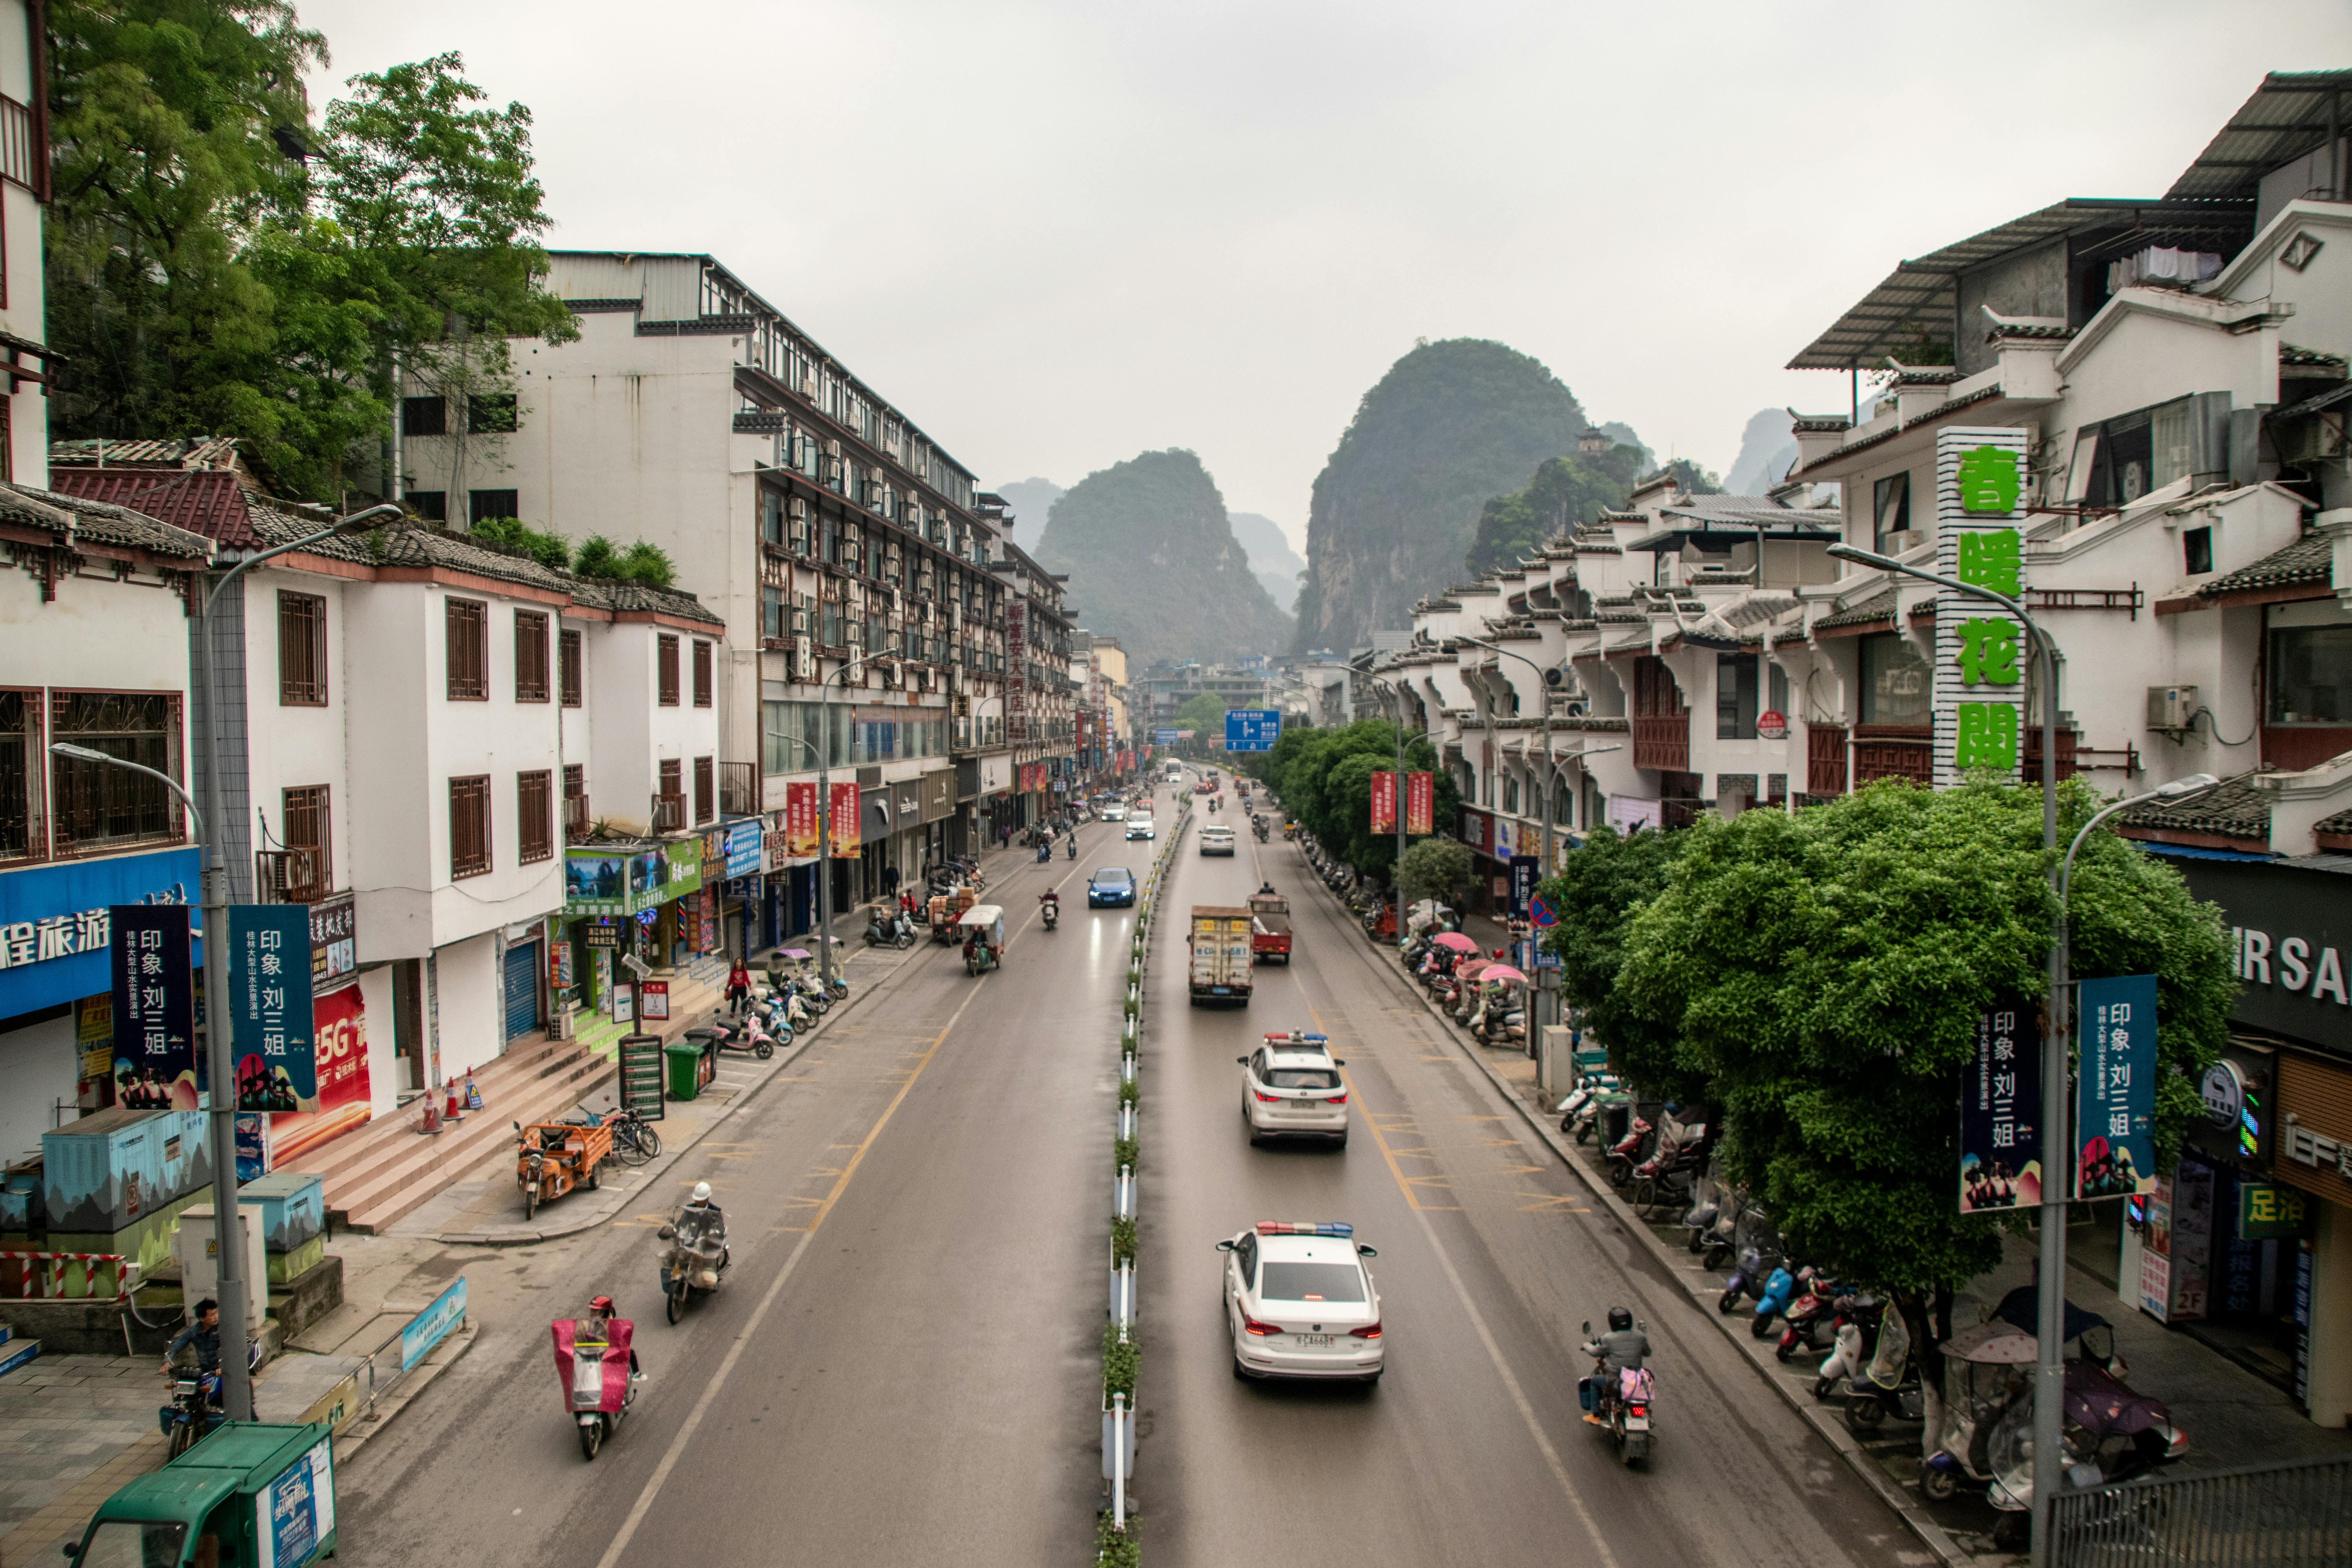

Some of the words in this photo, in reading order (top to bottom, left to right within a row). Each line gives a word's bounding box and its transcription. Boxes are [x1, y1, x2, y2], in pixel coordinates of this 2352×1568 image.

[1956, 445, 2022, 770] 春暖花開
[564, 905, 623, 915] 之旅旅游部
[731, 878, 744, 895] P
[126, 931, 138, 1019] 桂林大型山水实景演出
[141, 929, 167, 1055] 印象·刘三姐
[246, 931, 258, 1019] 桂林大型山水实景演出
[260, 929, 286, 1055] 印象·刘三姐
[1992, 1011, 2015, 1148] 印象·刘三姐
[2097, 1005, 2107, 1100] 桂林大型山水实景演出
[2109, 1003, 2131, 1137] 印象·刘三姐
[2179, 1293, 2201, 1308] 2F
